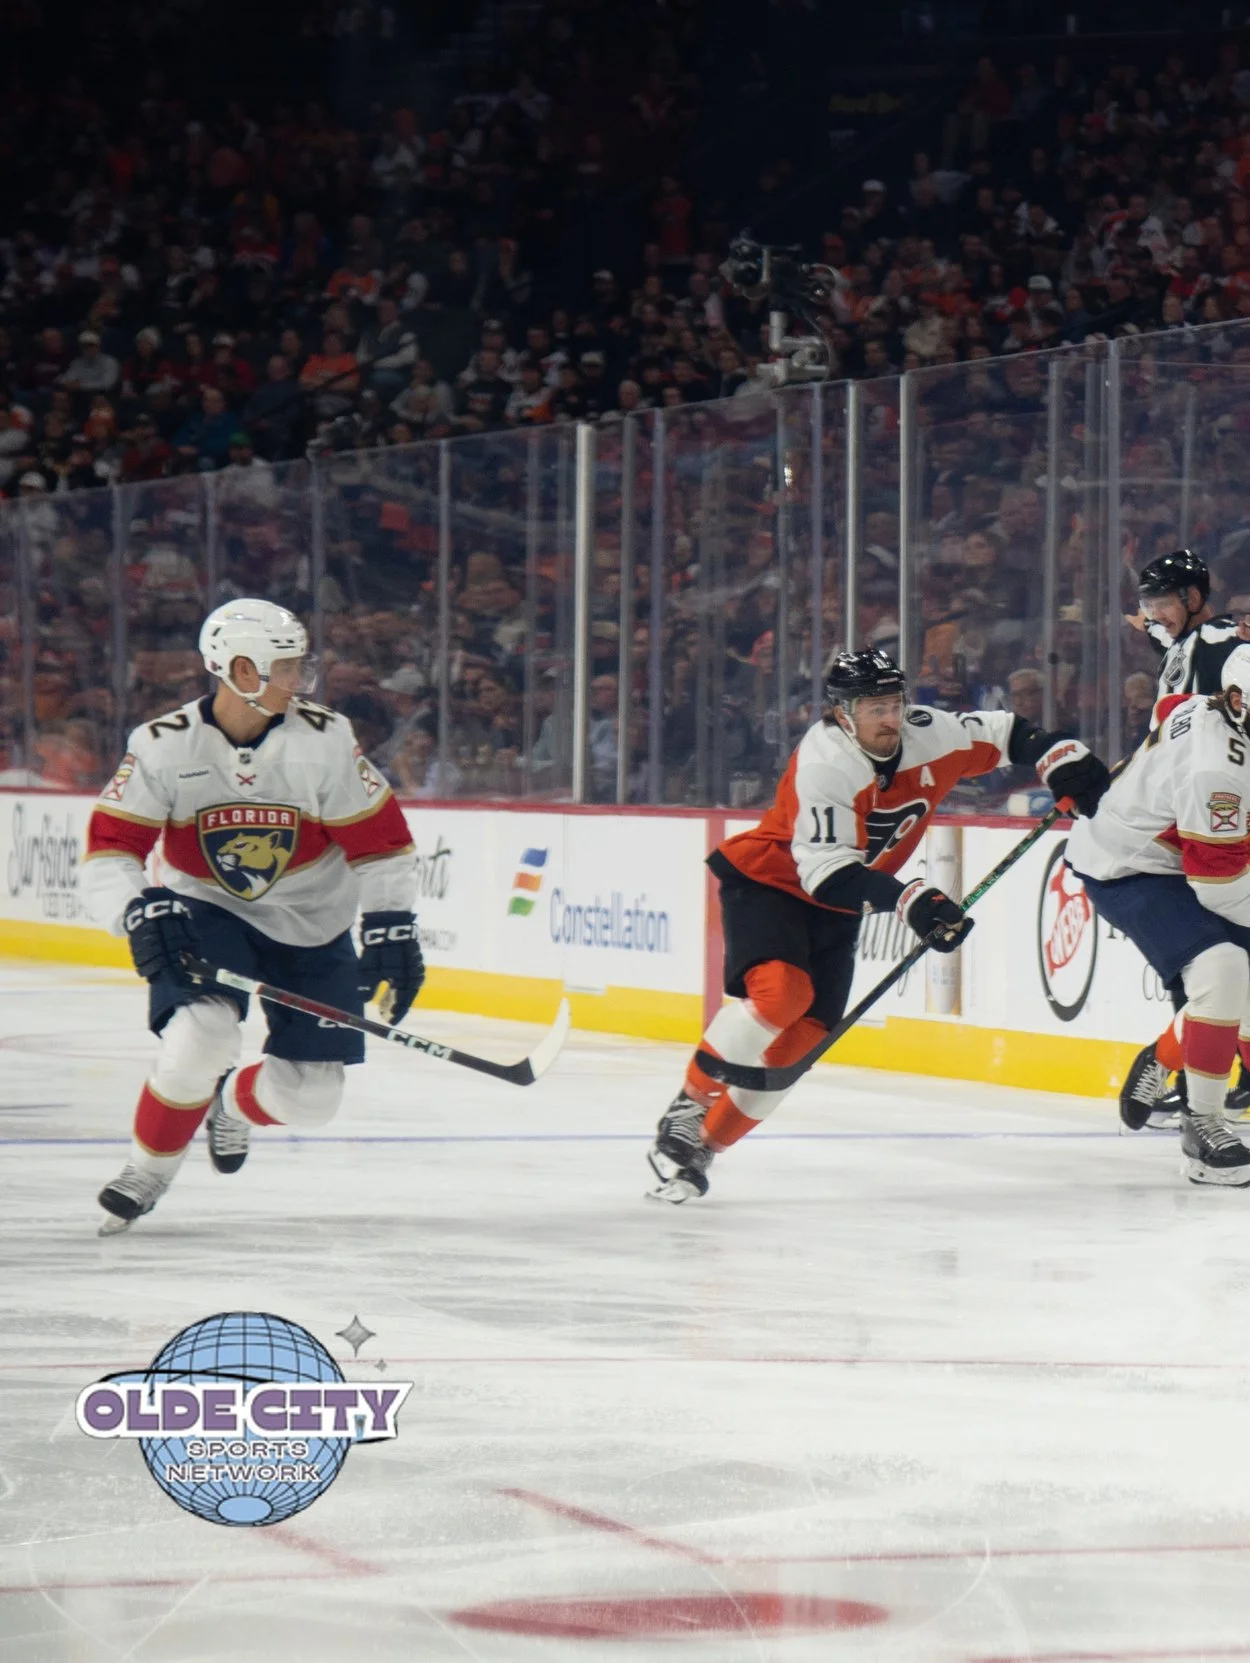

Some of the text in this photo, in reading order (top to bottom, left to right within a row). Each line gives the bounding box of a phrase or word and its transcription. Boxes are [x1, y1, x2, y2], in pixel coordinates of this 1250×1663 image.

[1227, 737, 1246, 767] 5
[919, 765, 936, 788] A
[207, 808, 292, 827] FLORIDA
[810, 806, 837, 844] 11
[550, 886, 670, 953] Constellation
[386, 1029, 453, 1061] CCM
